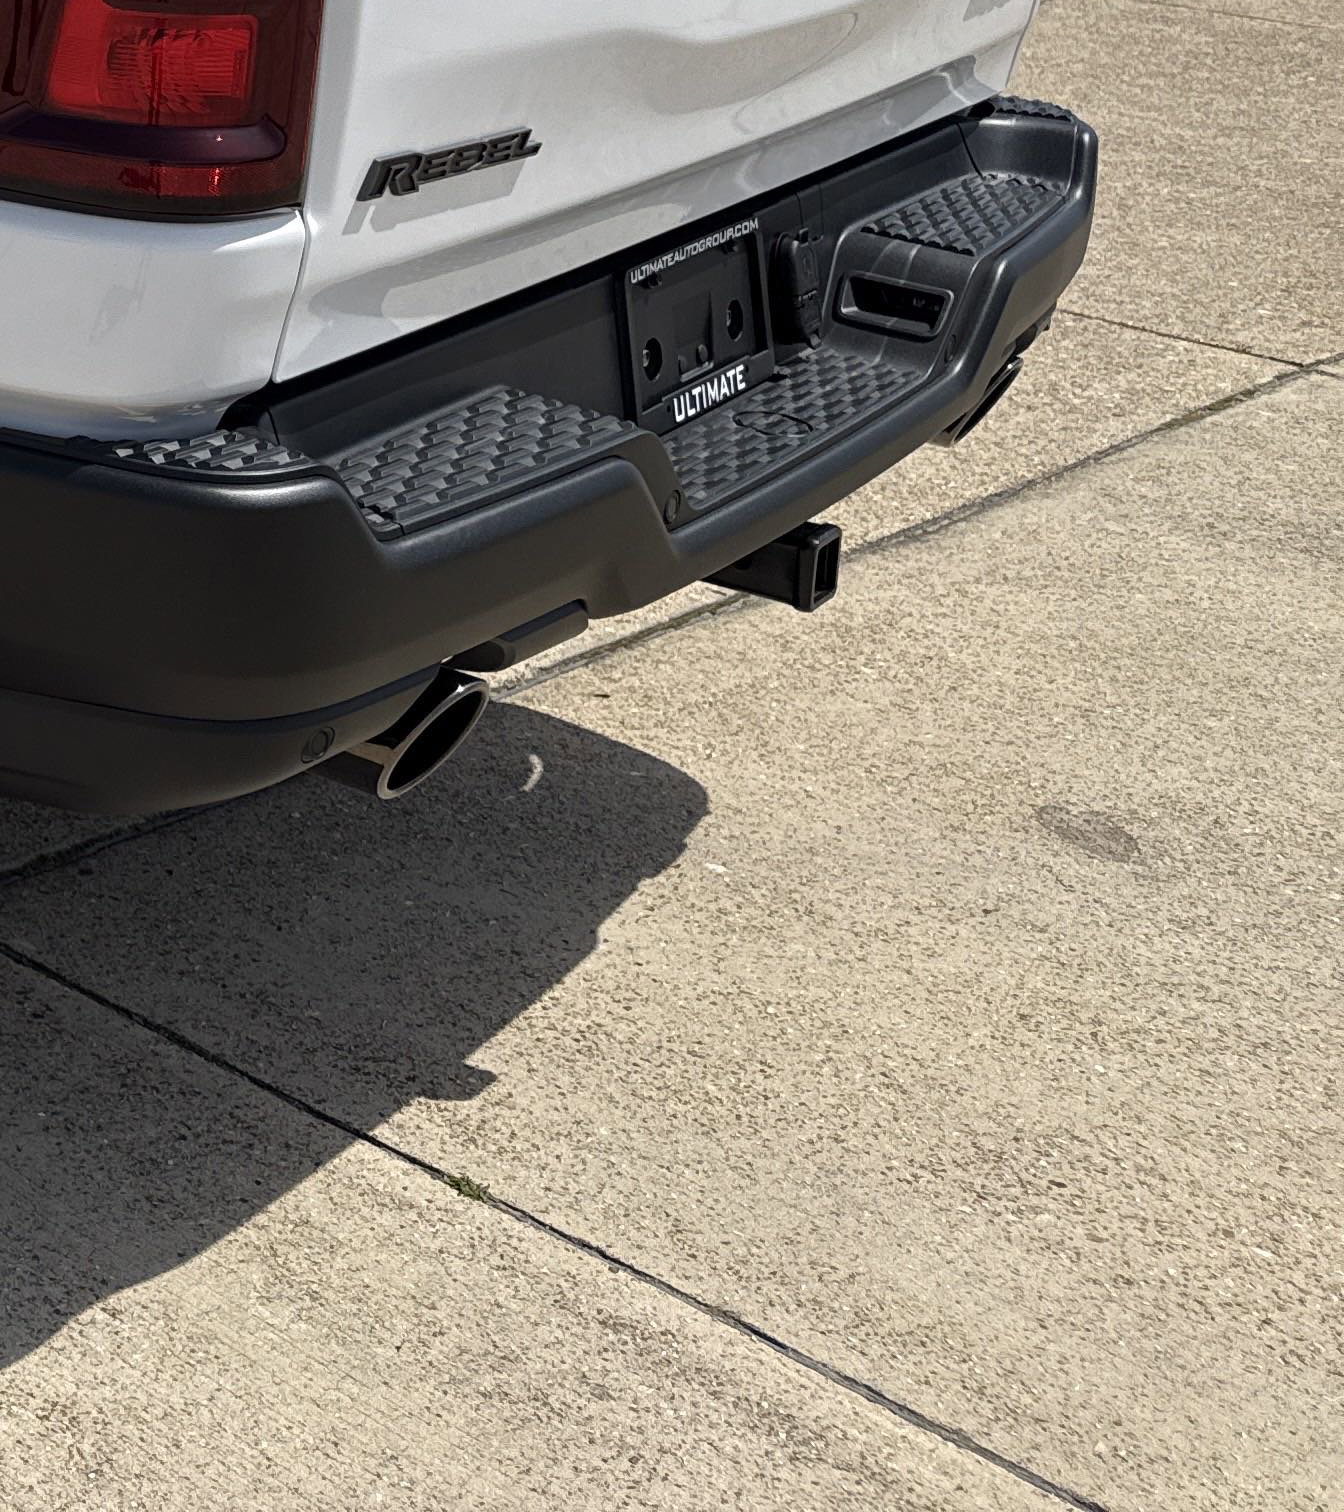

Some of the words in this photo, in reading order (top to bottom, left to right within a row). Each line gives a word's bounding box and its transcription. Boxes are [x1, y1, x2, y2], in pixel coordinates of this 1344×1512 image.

[356, 127, 543, 202] REBEL
[630, 217, 759, 284] ULTIMATEAUTOGROUP.COM
[673, 364, 746, 423] ULTIMATE
